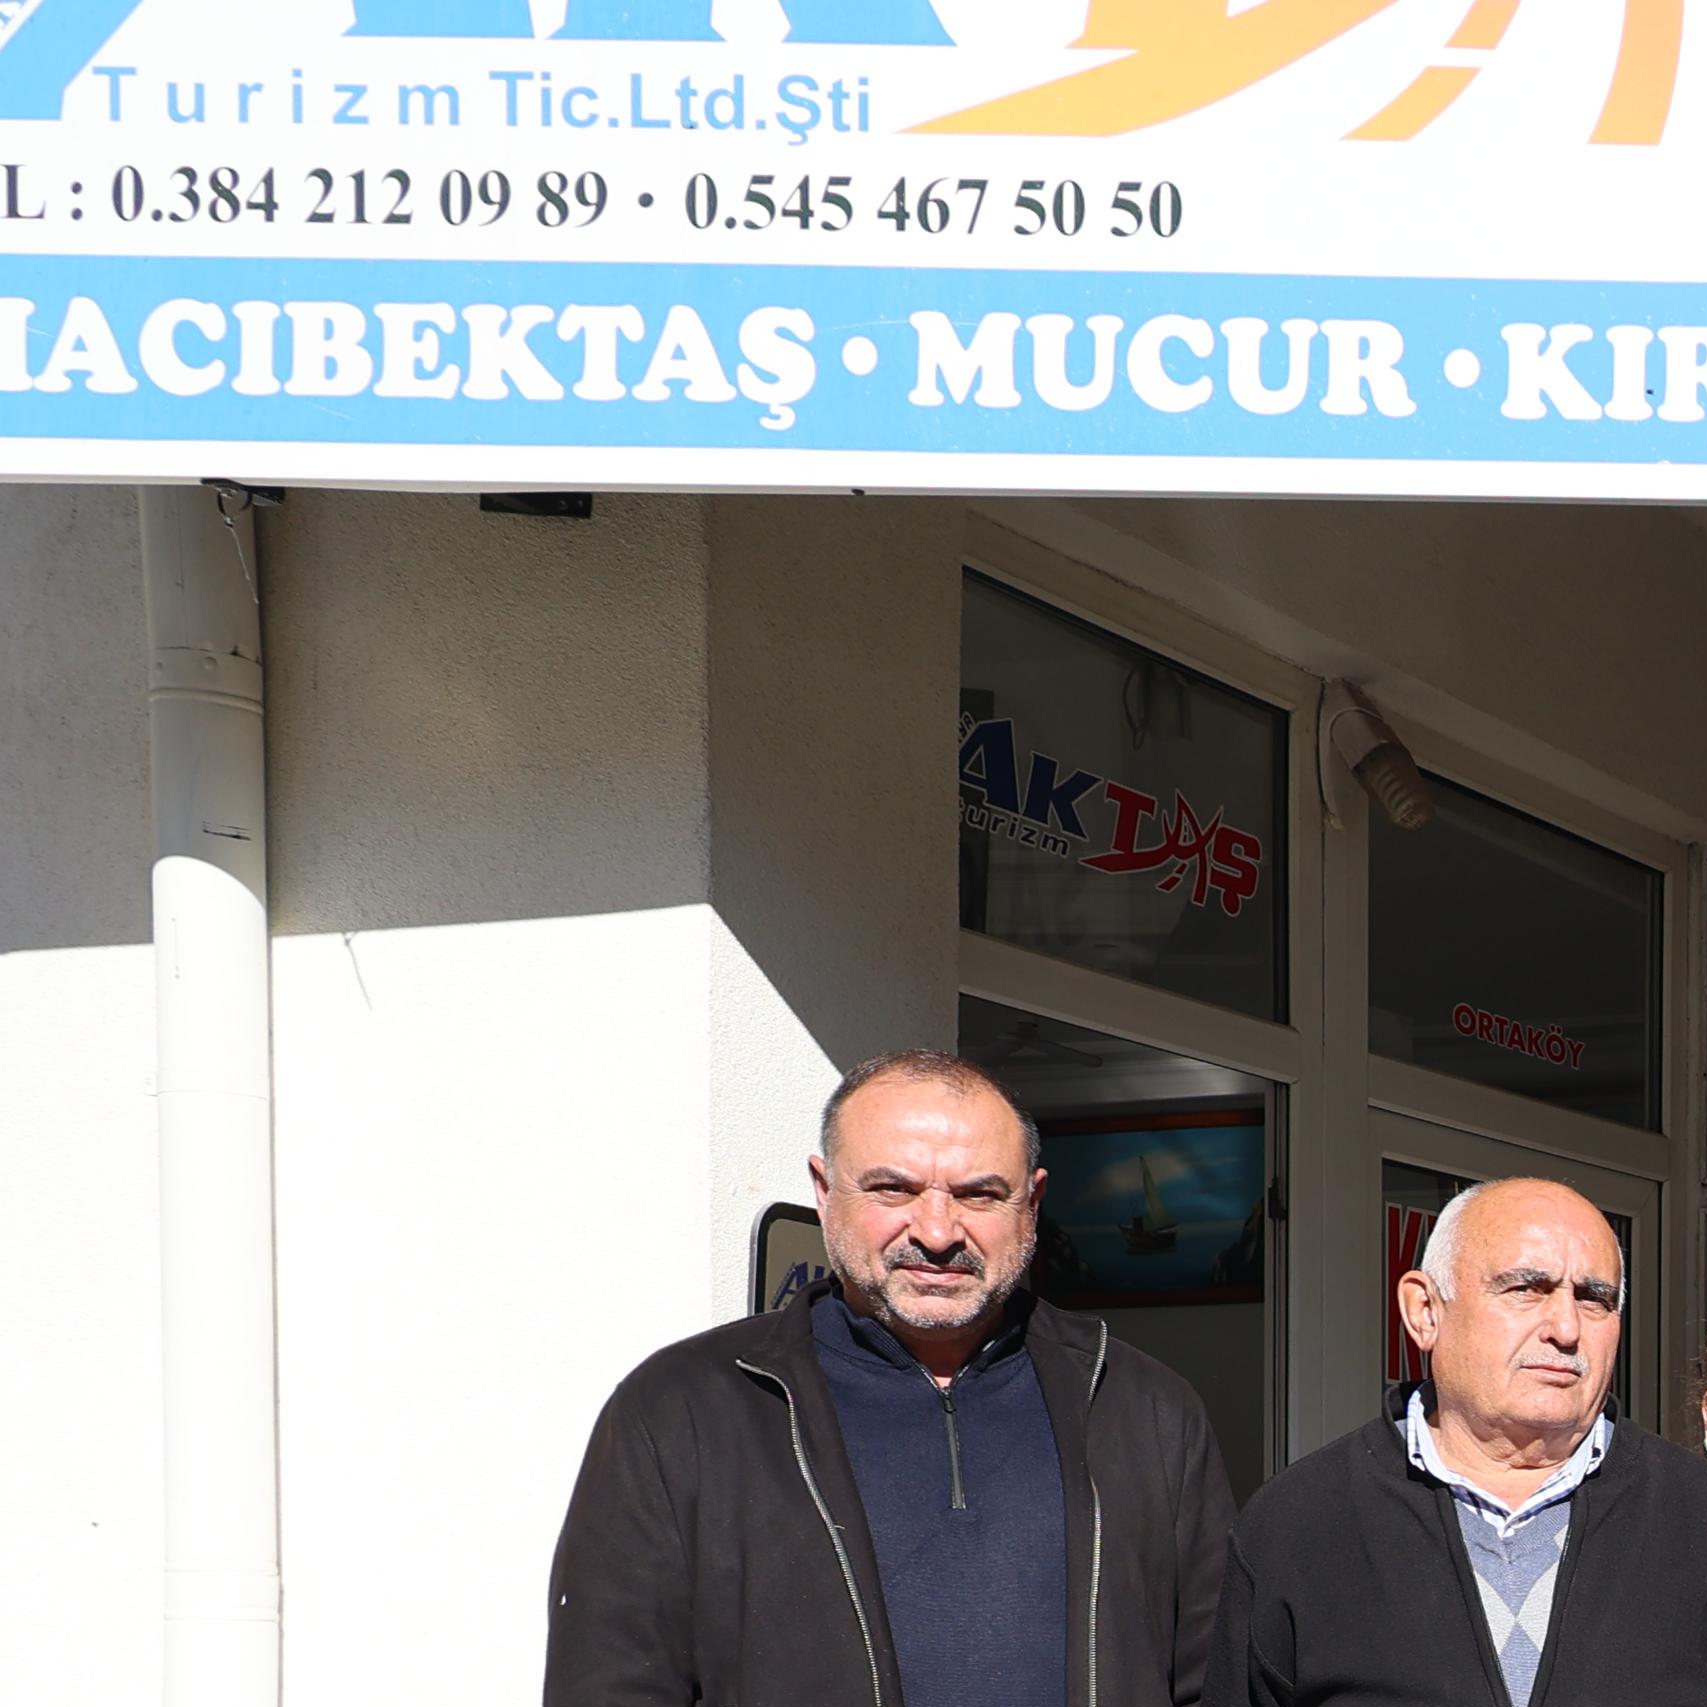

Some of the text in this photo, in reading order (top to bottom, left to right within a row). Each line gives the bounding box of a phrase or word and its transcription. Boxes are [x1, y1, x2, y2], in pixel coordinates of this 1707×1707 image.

[92, 65, 870, 146] Turizm Tic.Ltd.Şti
[112, 164, 279, 223] 0.384
[304, 167, 411, 224] 212
[439, 169, 511, 226] 09
[536, 170, 608, 228] 89
[685, 172, 854, 231] 0.545
[877, 176, 988, 234] 467
[1014, 179, 1085, 236] 50
[1110, 181, 1182, 238] 50
[908, 310, 1417, 418] MUCUR
[1452, 1002, 1586, 1071] ORTAKÖY
